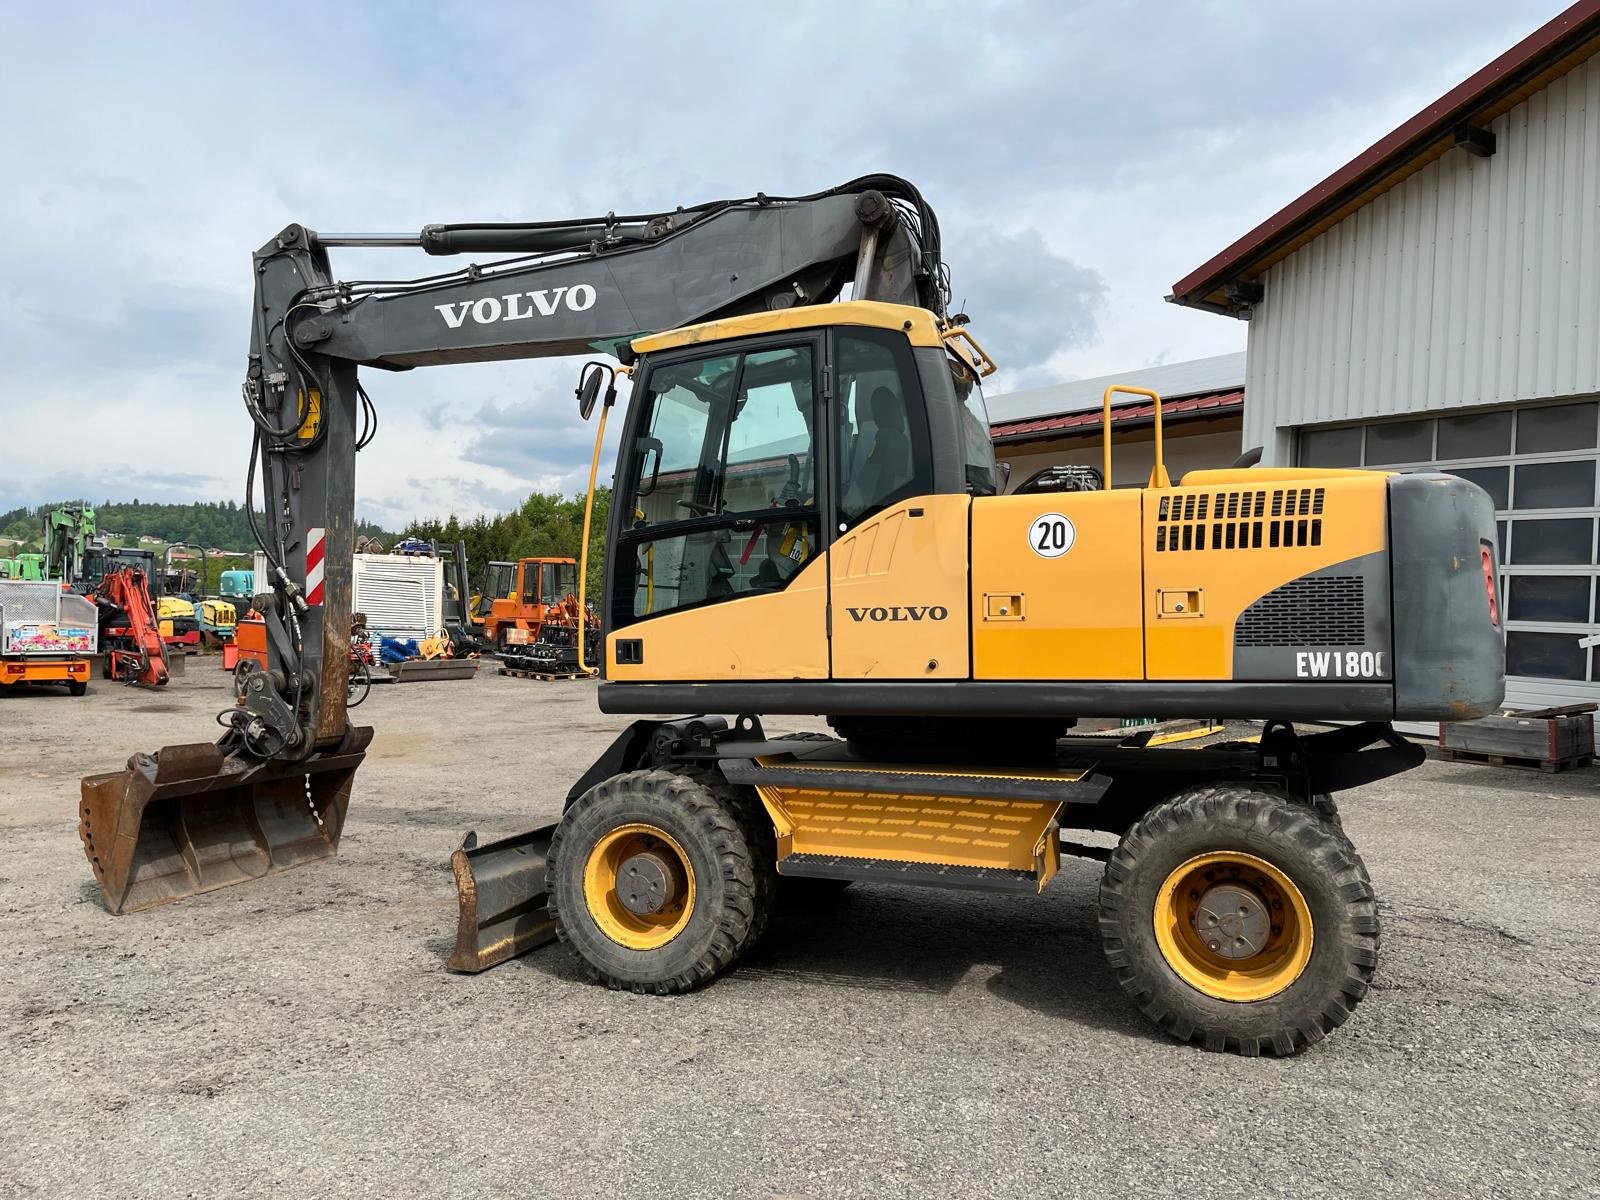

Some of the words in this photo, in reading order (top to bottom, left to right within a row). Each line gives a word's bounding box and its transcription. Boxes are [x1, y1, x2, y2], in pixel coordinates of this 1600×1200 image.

[434, 284, 597, 328] VOLVO
[1038, 521, 1066, 550] 20
[845, 606, 948, 622] VOLVO
